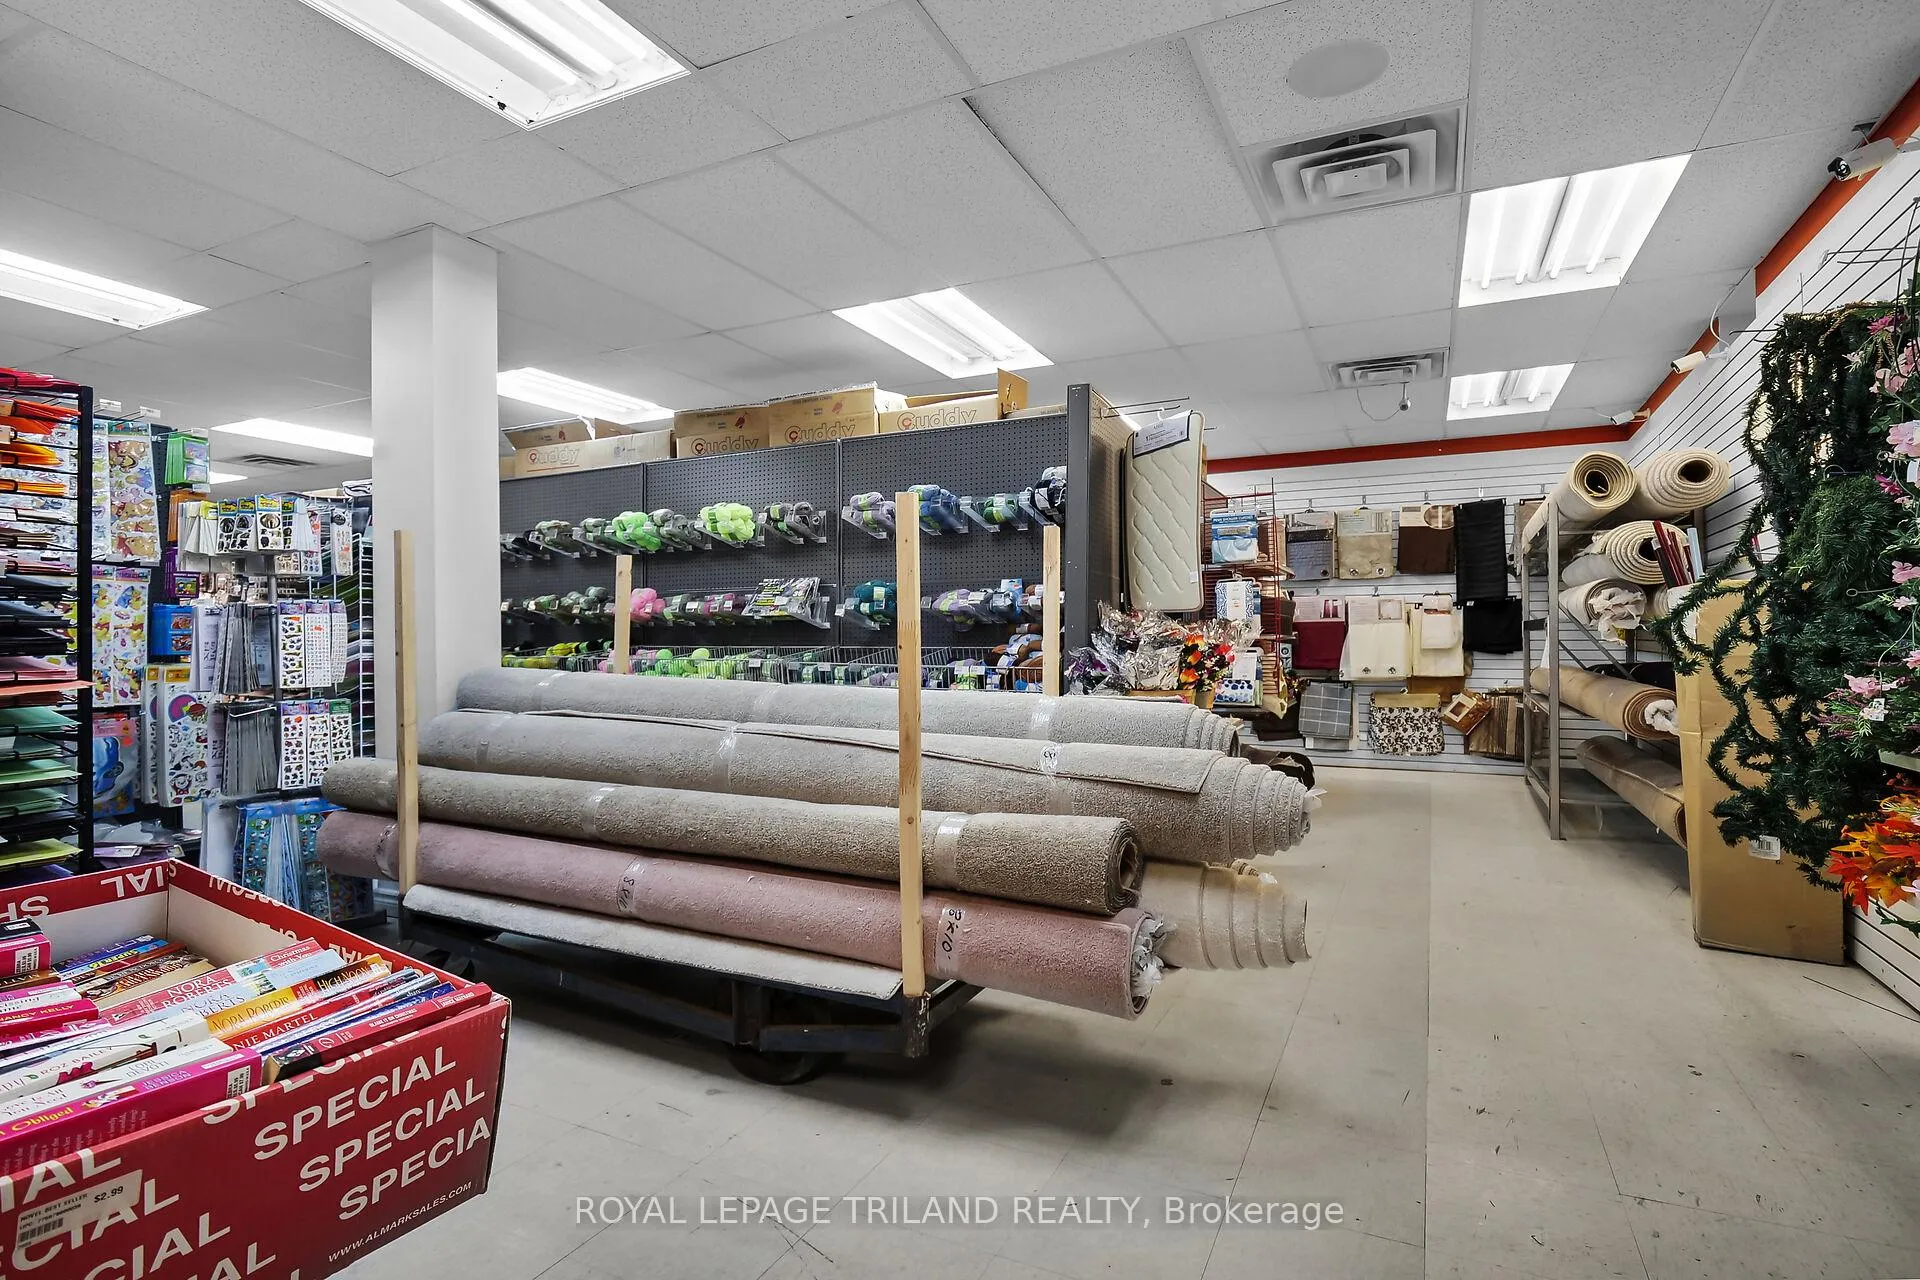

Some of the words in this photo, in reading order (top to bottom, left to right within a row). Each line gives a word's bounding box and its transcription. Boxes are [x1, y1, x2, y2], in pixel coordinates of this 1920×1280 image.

[897, 407, 977, 431] Cuddy
[785, 420, 855, 445] Cuddy
[527, 447, 579, 466] Cuddy
[691, 436, 758, 456] Cuddy
[270, 945, 311, 962] Christmas
[163, 978, 233, 1008] ROBERTS
[167, 975, 217, 998] NORA
[317, 974, 342, 992] HIGH
[40, 1004, 74, 1015] KELLY
[200, 995, 246, 1017] BERTS
[211, 1015, 245, 1032] NORA
[232, 1035, 260, 1051] NIE
[264, 1012, 318, 1040] MARTEL
[41, 1063, 67, 1075] ROZ
[254, 1046, 456, 1161] SPECIAL
[12, 1107, 74, 1131] Obliged
[299, 1077, 486, 1192] SPECIAL
[339, 1117, 491, 1221] SPECIA
[20, 1210, 42, 1222] NOVEL
[44, 1202, 61, 1213] BEST
[93, 1185, 124, 1203] $2.99
[328, 1181, 472, 1263] WWW.ALMARKSALES.COM
